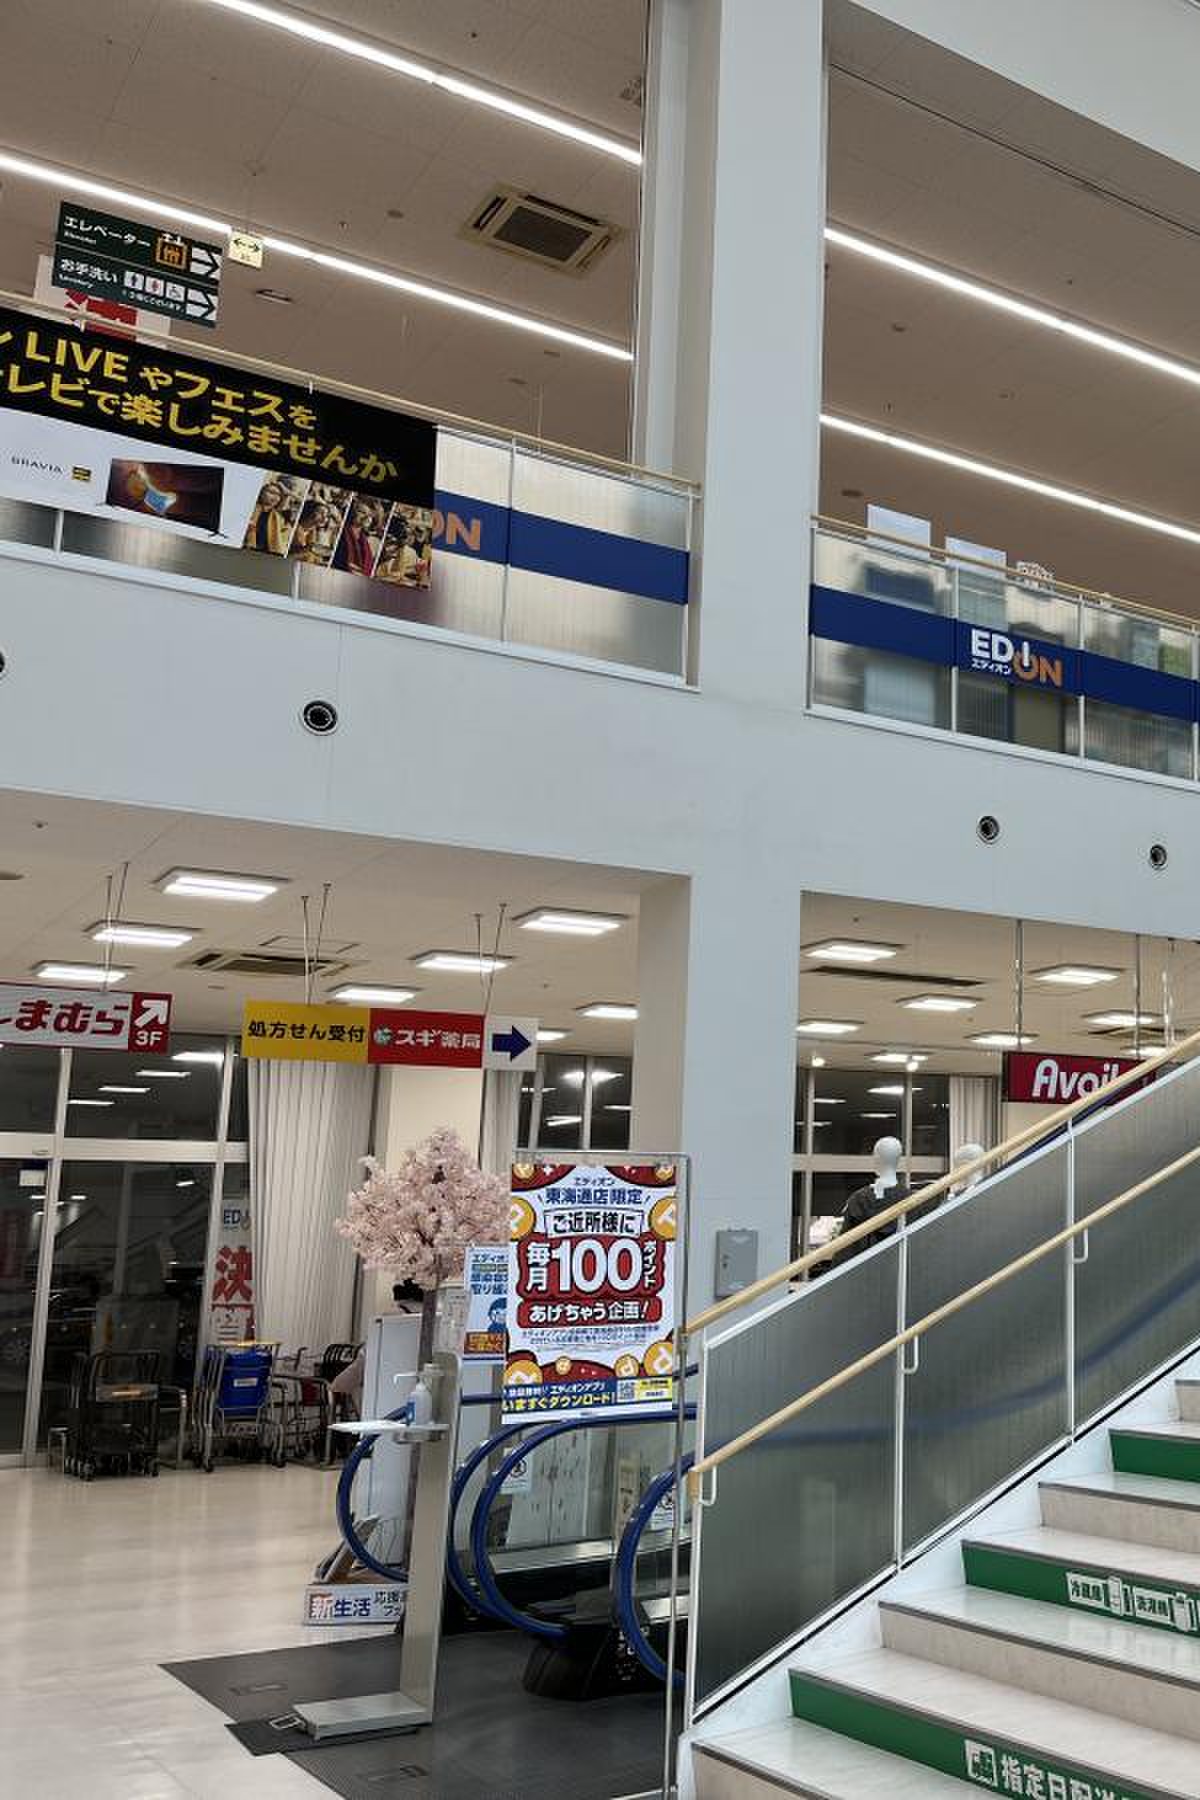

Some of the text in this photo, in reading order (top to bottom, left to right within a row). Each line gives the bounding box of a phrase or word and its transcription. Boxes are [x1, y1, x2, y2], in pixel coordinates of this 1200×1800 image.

[63, 214, 151, 247] エレベーター
[60, 258, 118, 284] お手洗い
[26, 330, 319, 430] LIVE やフェスを
[0, 362, 400, 484] レビで楽しみませんか
[971, 629, 1063, 688] EDION
[972, 661, 1011, 676] エディオン
[135, 1030, 163, 1047] 3F
[247, 1020, 365, 1044] 処方せん受付
[394, 1028, 481, 1050] スギ薬局
[552, 1211, 636, 1234] ご近所様に
[526, 1242, 551, 1292] 毎月
[556, 1239, 643, 1293] 100
